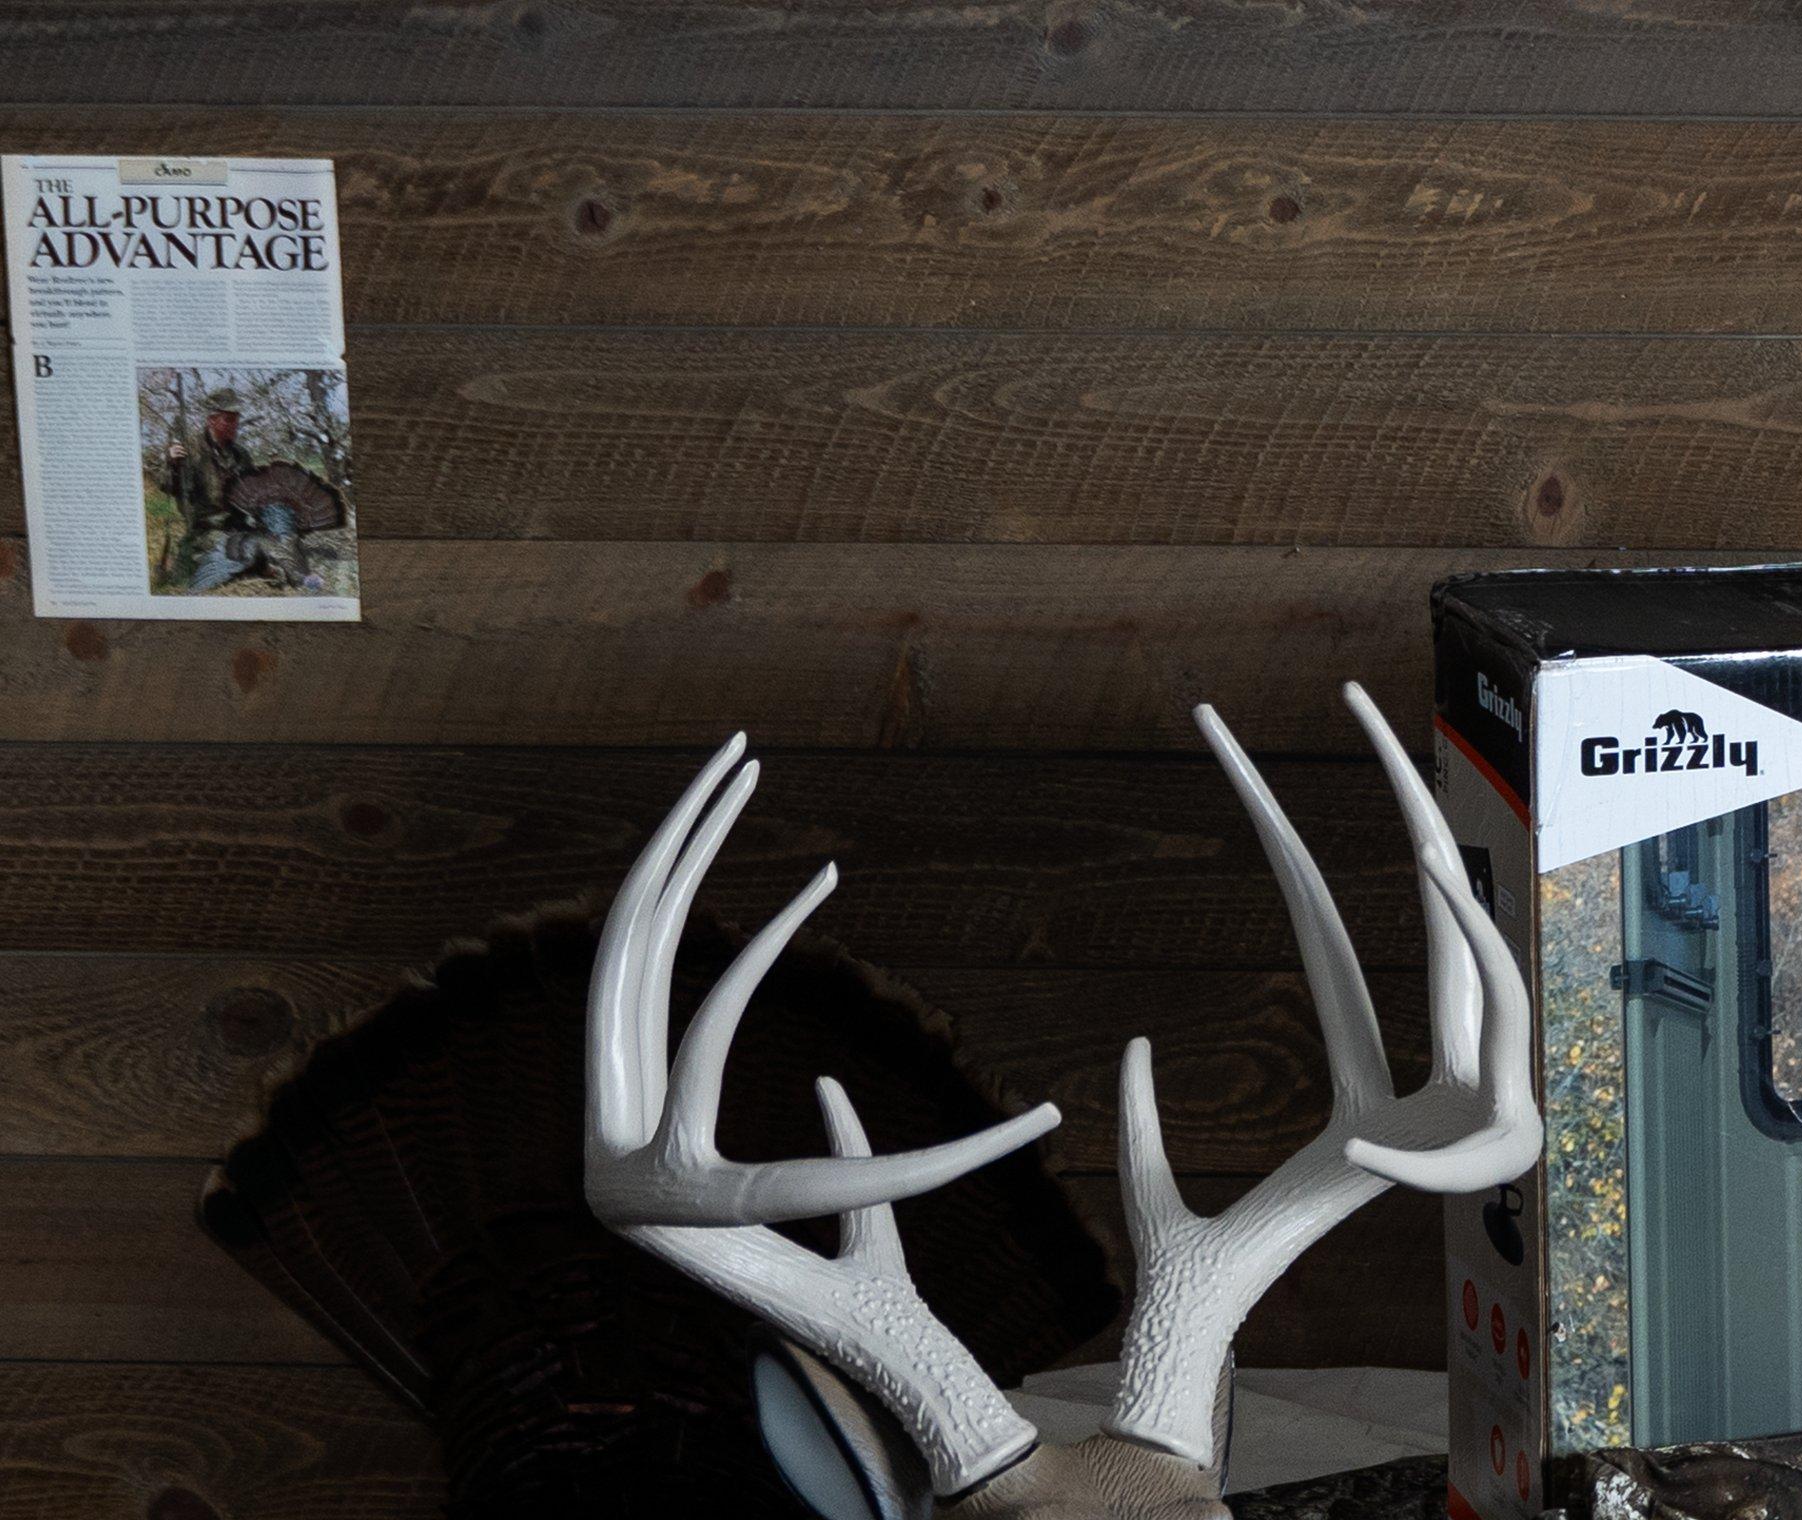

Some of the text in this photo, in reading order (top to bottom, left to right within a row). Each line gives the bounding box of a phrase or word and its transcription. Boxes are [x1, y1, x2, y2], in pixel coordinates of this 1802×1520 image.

[35, 178, 74, 194] THE
[27, 195, 326, 232] ALL-PURPOSE
[29, 231, 330, 272] ADVANTAGE
[1477, 670, 1523, 744] Grizzly
[1580, 733, 1759, 778] Grizzly
